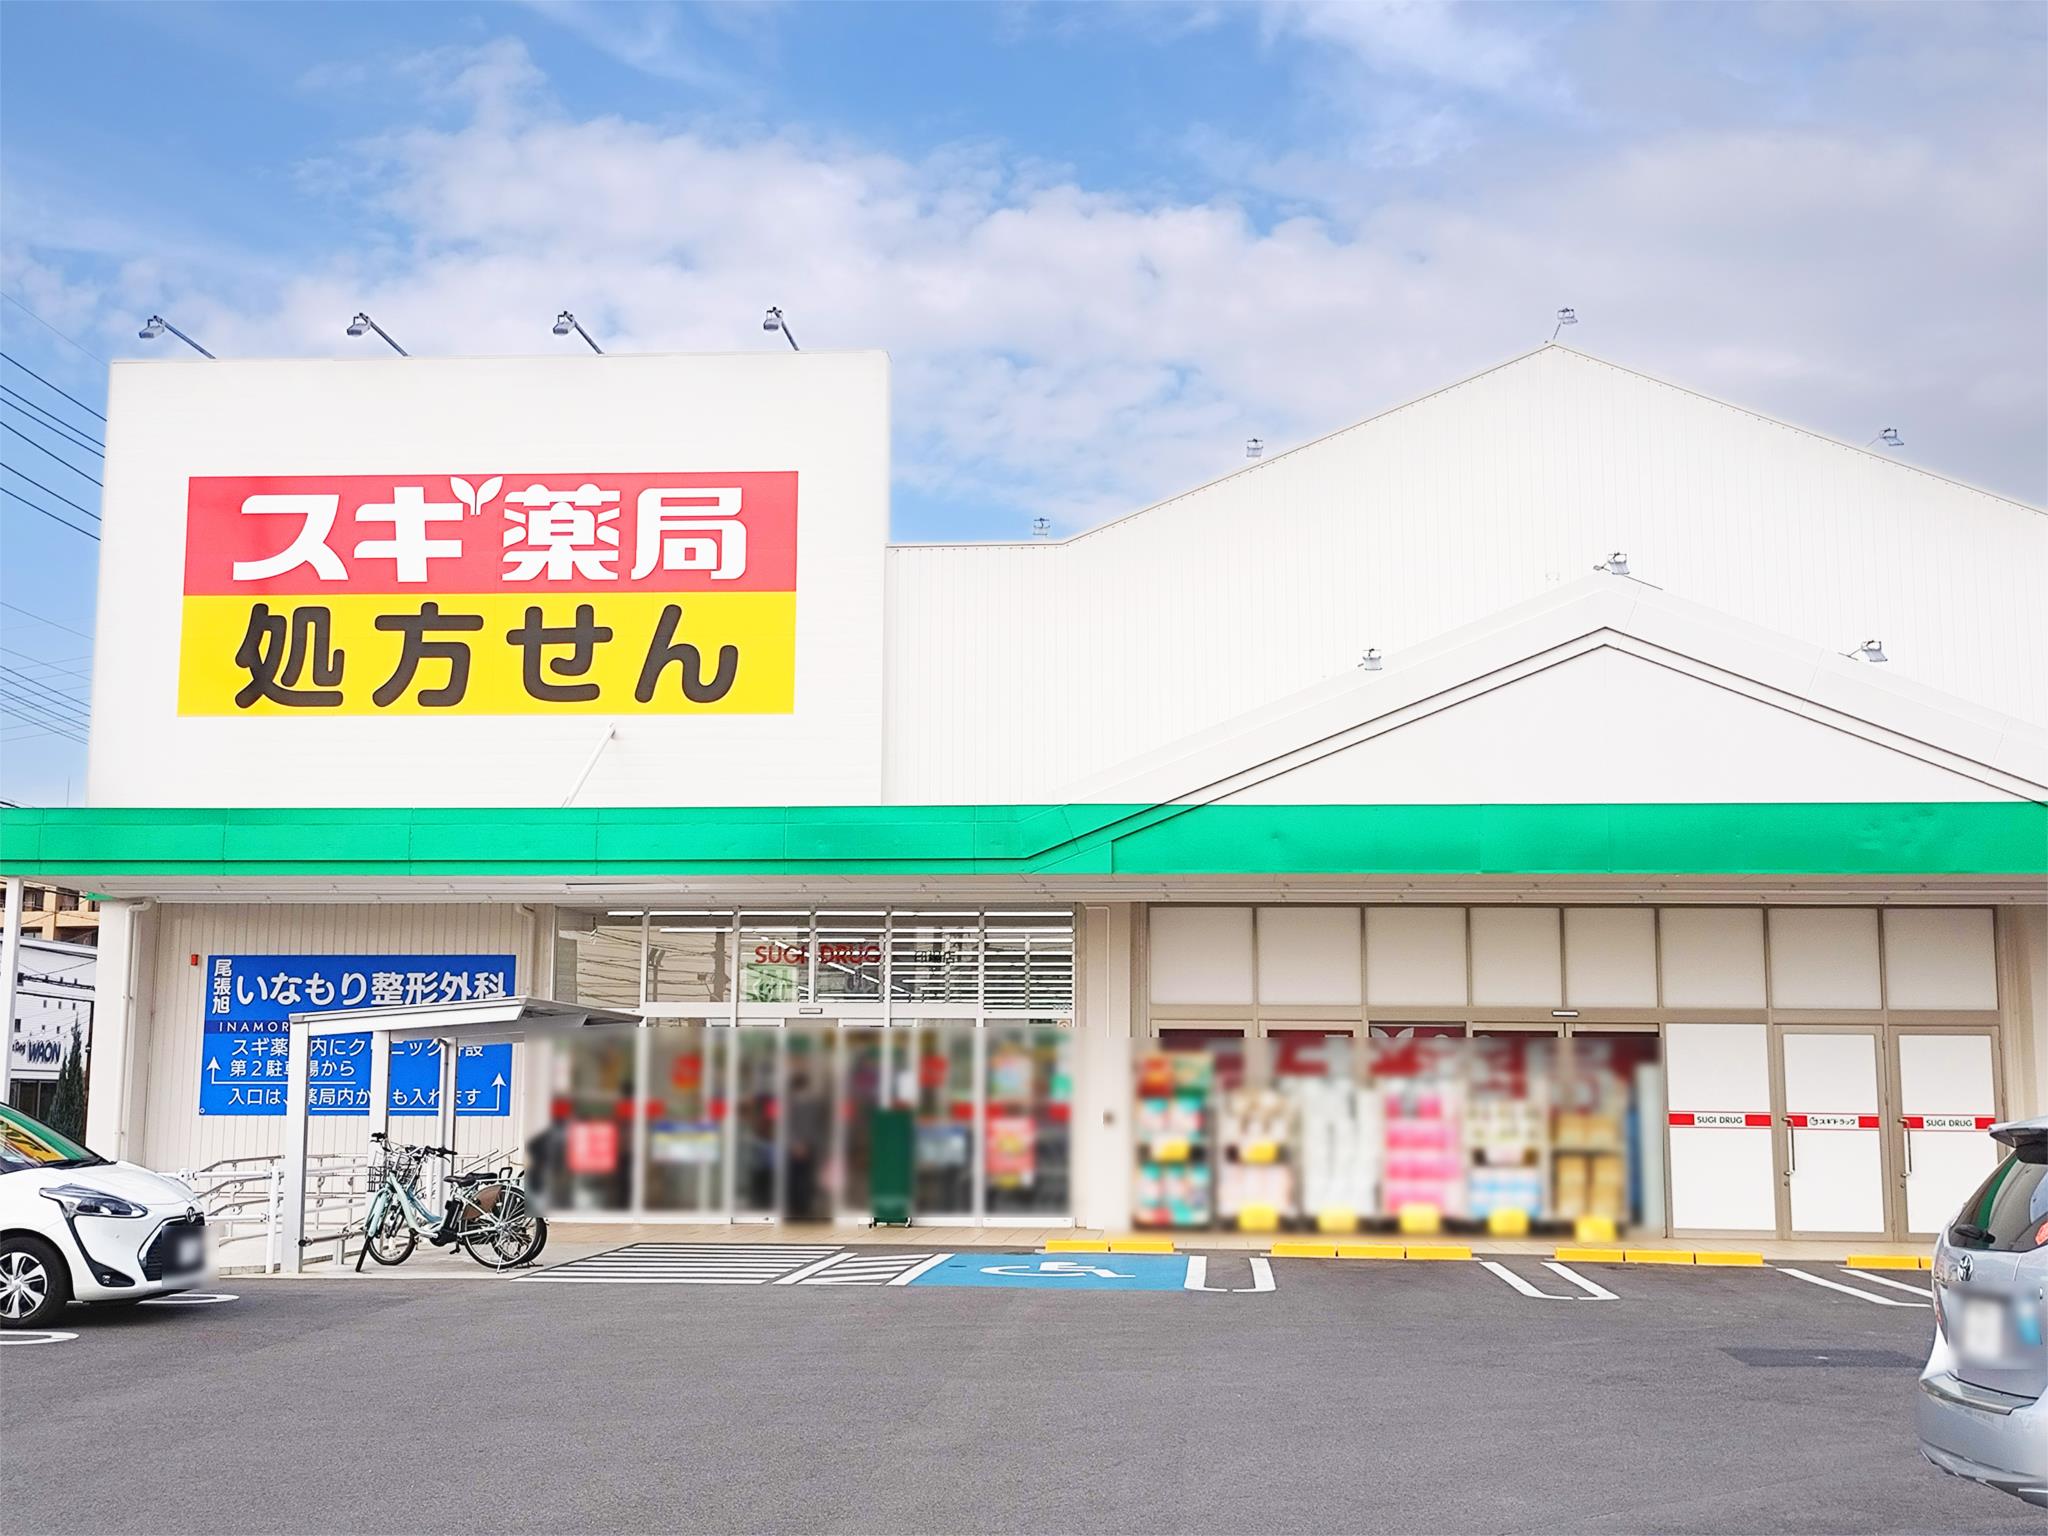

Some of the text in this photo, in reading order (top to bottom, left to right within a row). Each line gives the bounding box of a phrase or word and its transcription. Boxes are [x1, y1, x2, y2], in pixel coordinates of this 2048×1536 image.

[232, 476, 747, 582] スギ薬局
[234, 602, 738, 709] 処方せん
[755, 945, 807, 964] SUGI
[821, 944, 881, 964] DRUG
[212, 958, 233, 1014] 尾張旭
[236, 971, 506, 1006] いなもり整形外科
[219, 1021, 290, 1032] INAMOR
[1696, 1116, 1743, 1124] SUGI DRUG
[1926, 1119, 1973, 1127] SUGI DRUG
